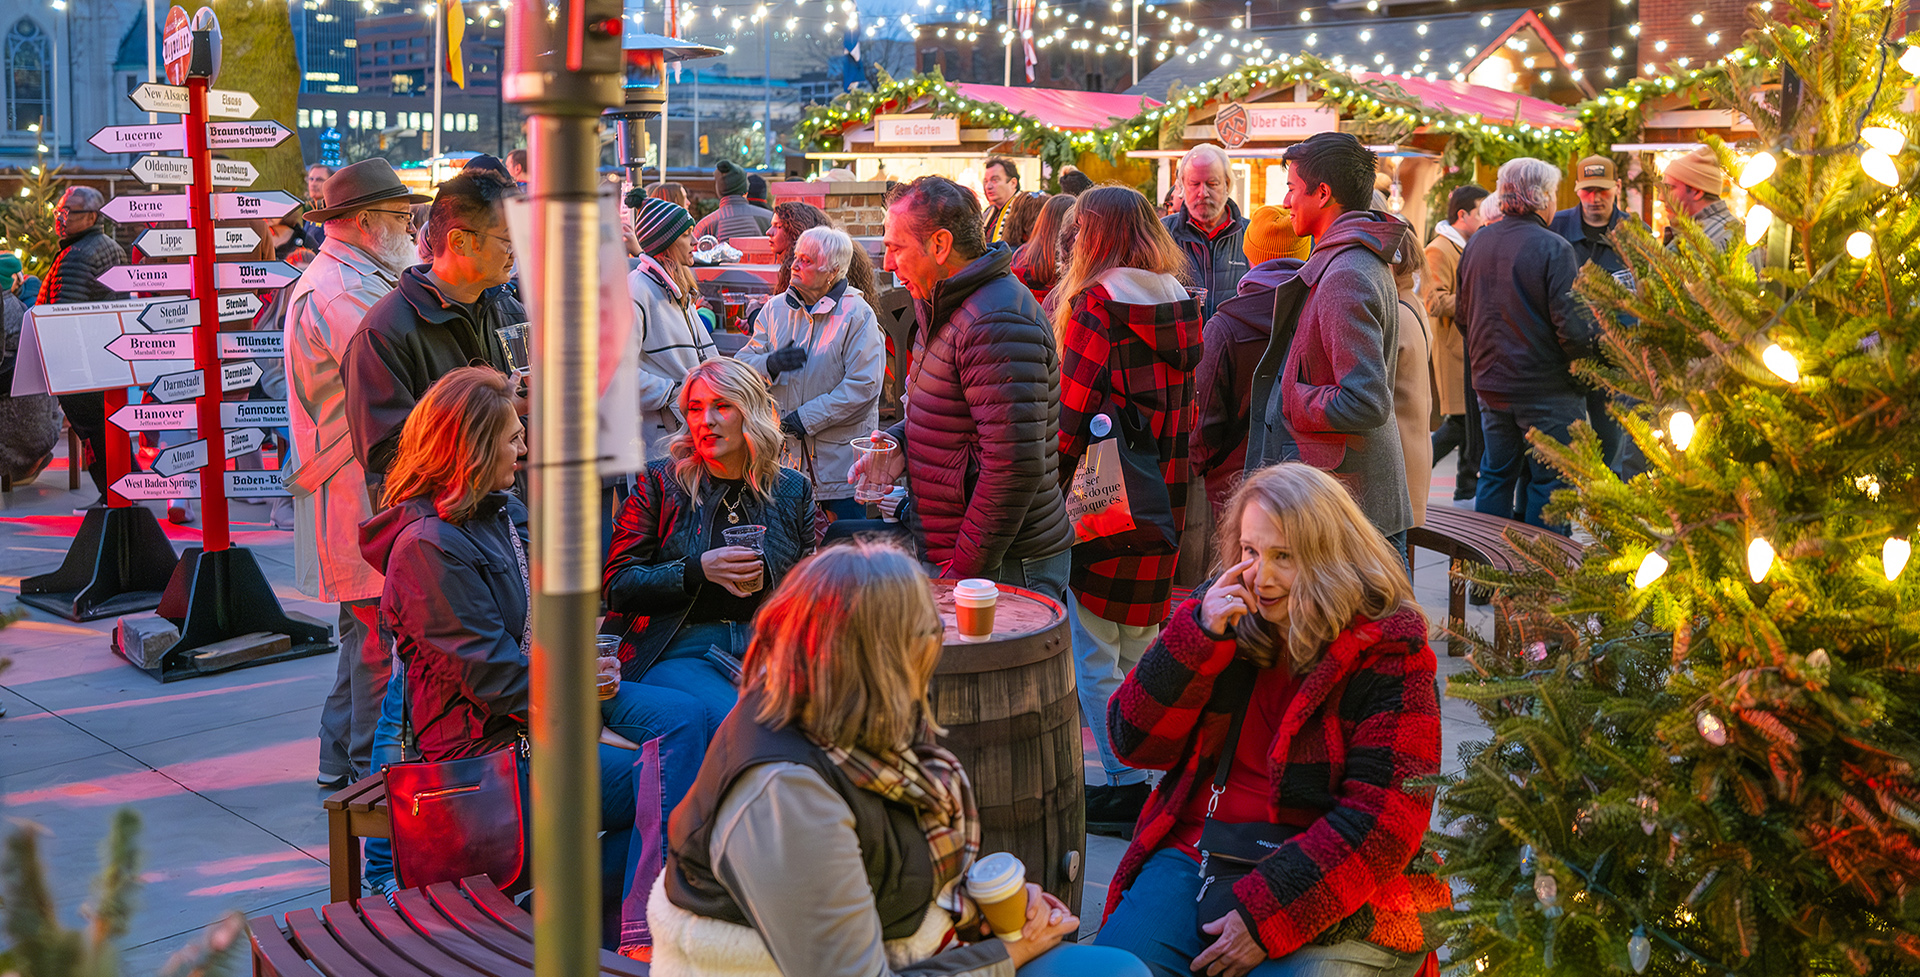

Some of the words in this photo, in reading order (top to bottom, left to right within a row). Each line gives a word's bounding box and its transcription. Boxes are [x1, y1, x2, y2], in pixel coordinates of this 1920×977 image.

[145, 87, 161, 99] New
[164, 90, 188, 102] Alsace
[1280, 114, 1307, 127] Gifts
[116, 130, 163, 141] Lucerne
[210, 125, 277, 136] Braunschweig
[895, 125, 912, 136] Gem
[913, 124, 941, 135] Garten
[145, 159, 188, 175] Oldenburg
[216, 163, 248, 176] Oldenburg
[129, 201, 162, 211] Berne
[237, 196, 261, 207] Bern
[160, 234, 182, 247] Lippe
[226, 231, 242, 243] Lippe
[127, 269, 168, 280] Vienna
[239, 266, 267, 277] Wien
[225, 297, 248, 309] Stendal
[160, 304, 188, 318] Stendal
[130, 338, 176, 349] Bremen
[236, 336, 281, 346] Münster
[163, 375, 200, 391] Darmstadt
[134, 409, 184, 419] Hanover
[238, 405, 286, 417] Hannover
[171, 450, 194, 464] Altona
[125, 479, 143, 488] West
[145, 478, 167, 488] Baden
[169, 477, 197, 490] Springs
[1086, 475, 1100, 487] ser
[1089, 487, 1100, 498] do
[1102, 483, 1121, 496] que
[1089, 498, 1107, 511] que
